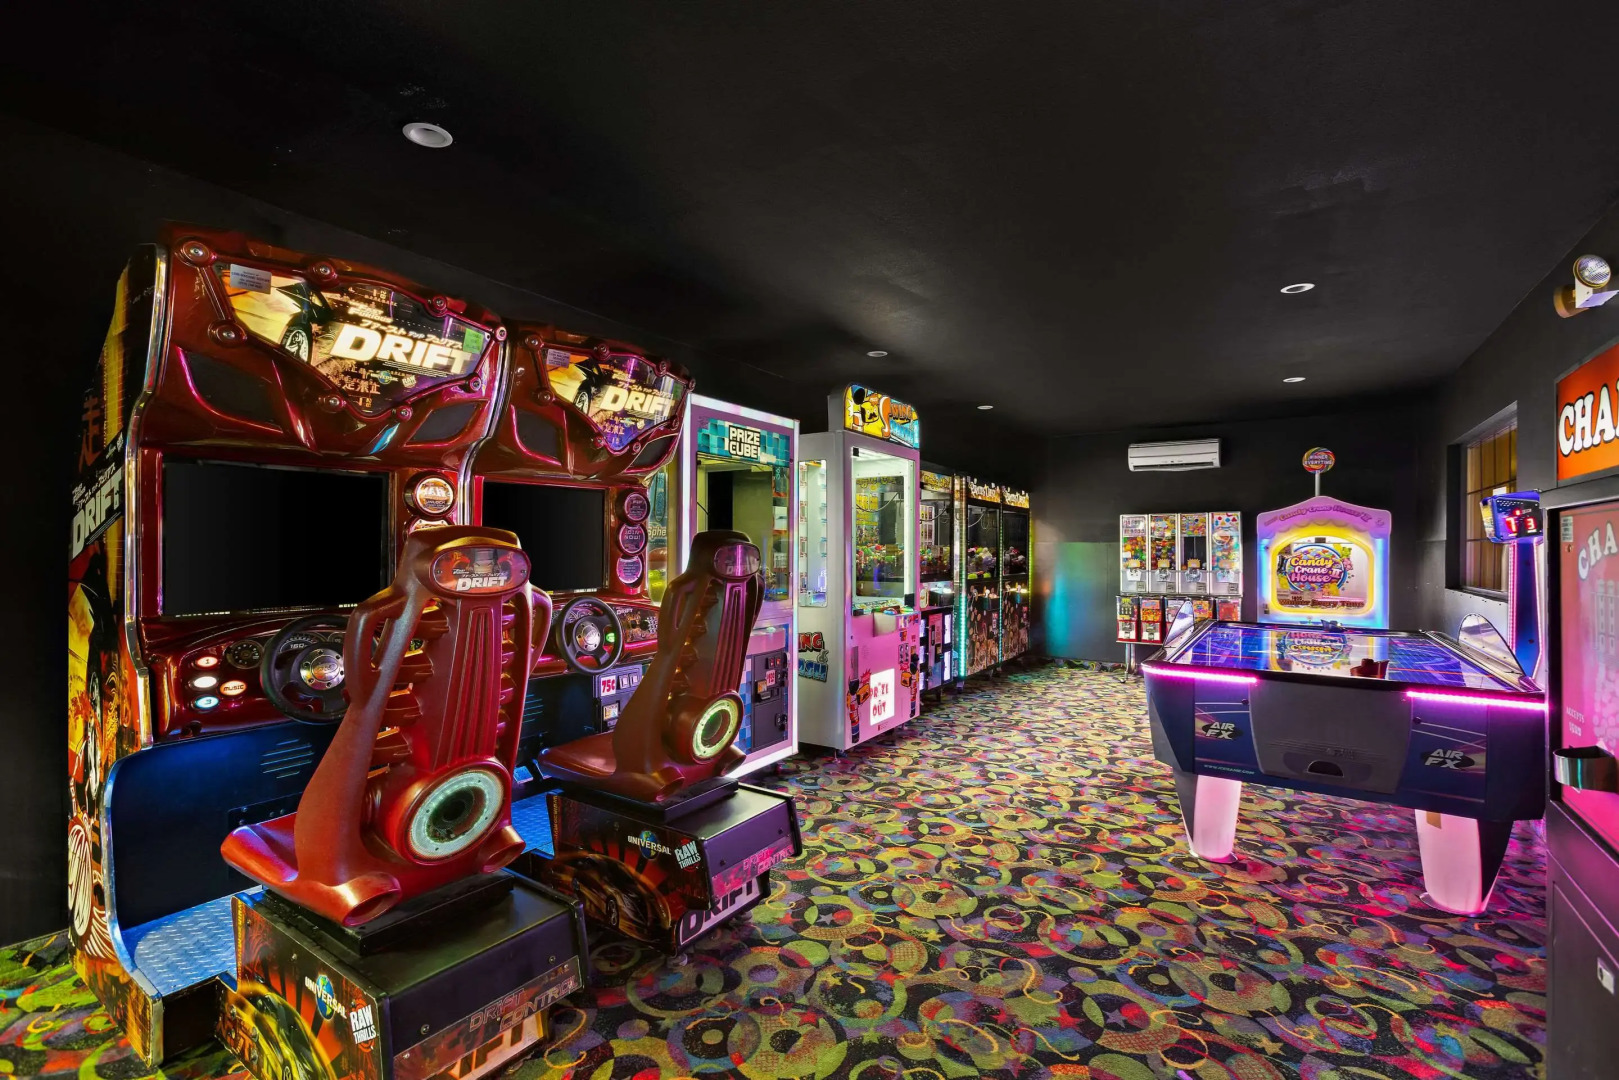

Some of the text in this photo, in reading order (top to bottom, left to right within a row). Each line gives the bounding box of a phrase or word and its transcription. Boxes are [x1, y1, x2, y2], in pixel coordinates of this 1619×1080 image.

[330, 322, 472, 375] DRIFT
[600, 385, 676, 421] DRIFT
[1558, 378, 1619, 457] CHA
[729, 426, 760, 446] PRIZE
[729, 440, 759, 459] CUBE
[72, 467, 122, 560] DRIFT
[1526, 517, 1536, 530] 3
[1578, 522, 1617, 580] CHA
[1290, 557, 1334, 568] Candy
[1294, 565, 1328, 574] Crane
[456, 576, 508, 592] DRIFT
[1291, 572, 1331, 583] House
[1205, 728, 1233, 740] FX
[1210, 721, 1235, 731] AIR
[1424, 756, 1461, 770] FX
[1430, 748, 1464, 760] AIR
[627, 835, 672, 856] UNIVERSAL
[674, 840, 698, 862] RAW
[678, 853, 701, 870] THRILLS
[304, 976, 347, 1019] UNIVERSAL
[500, 975, 578, 1030] CONTROL
[350, 1005, 374, 1031] RAW
[469, 988, 525, 1032] DRIFT
[353, 1025, 377, 1044] THRILLS
